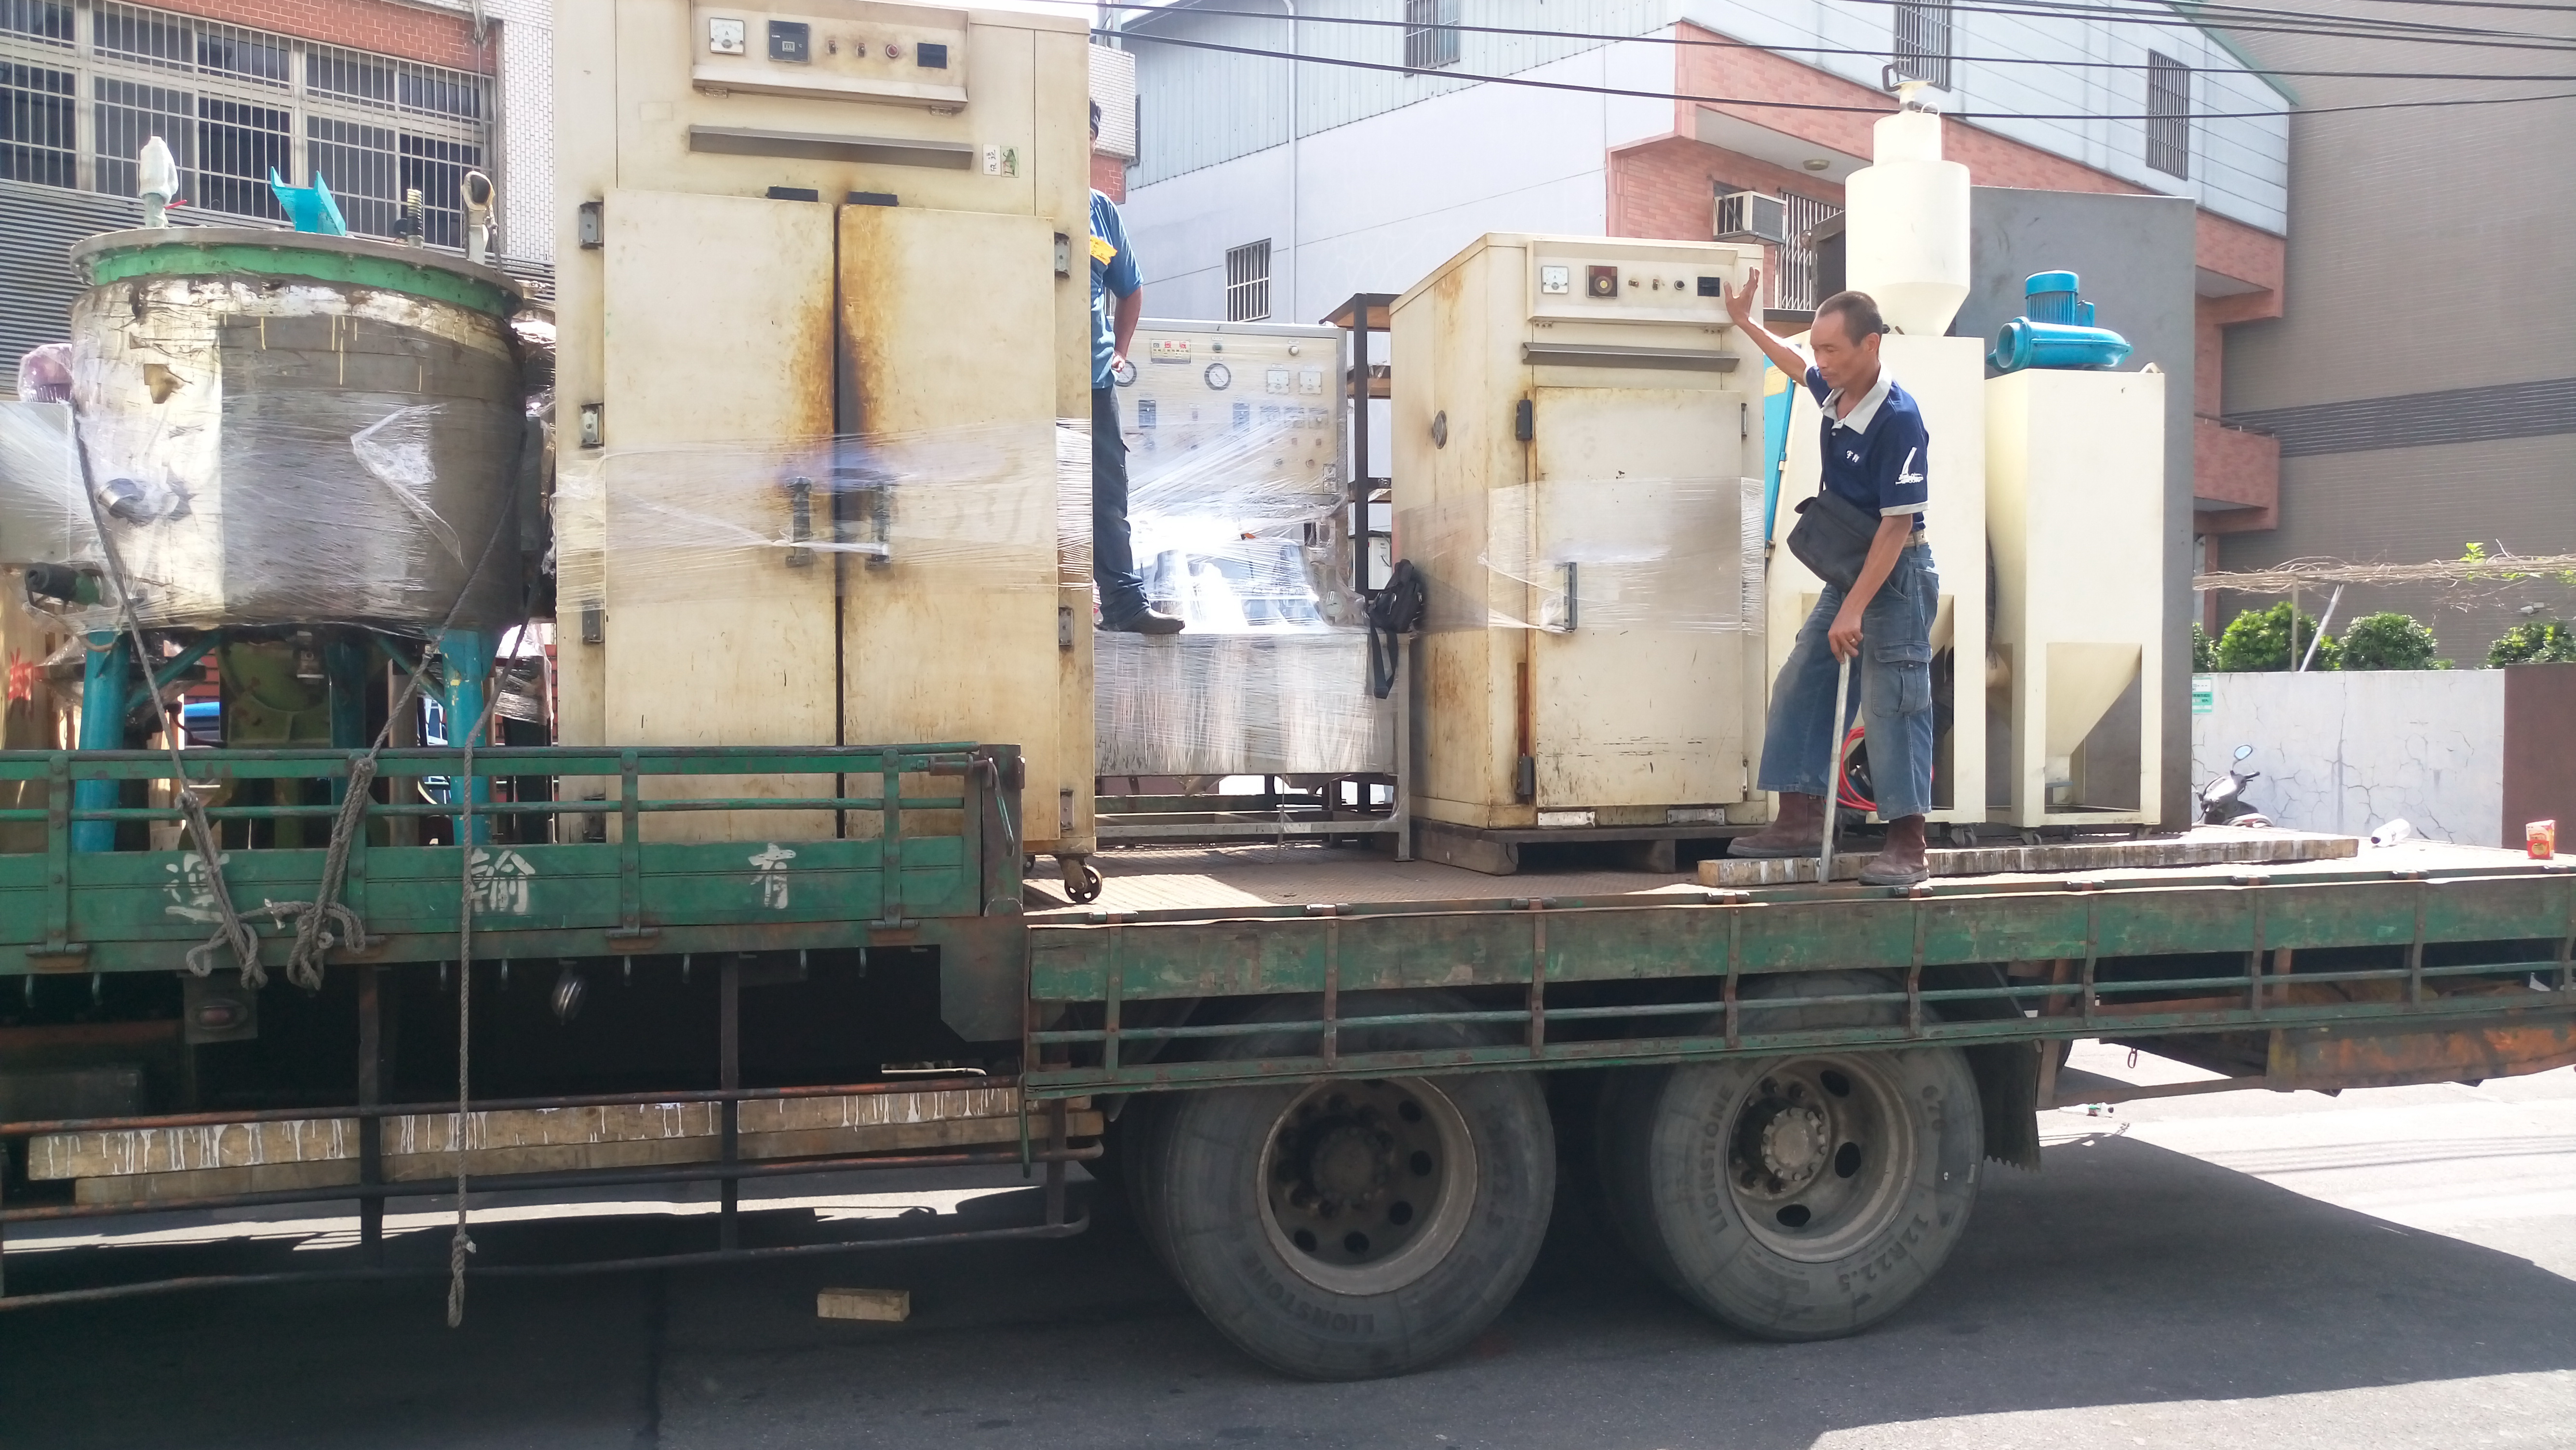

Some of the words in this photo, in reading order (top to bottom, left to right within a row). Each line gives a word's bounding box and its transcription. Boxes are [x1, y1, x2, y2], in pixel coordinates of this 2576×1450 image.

[1699, 1085, 1734, 1235] LIONSTONE
[1240, 1249, 1374, 1334] LIONSTONE
[1838, 1213, 1928, 1293] 12R22.5
